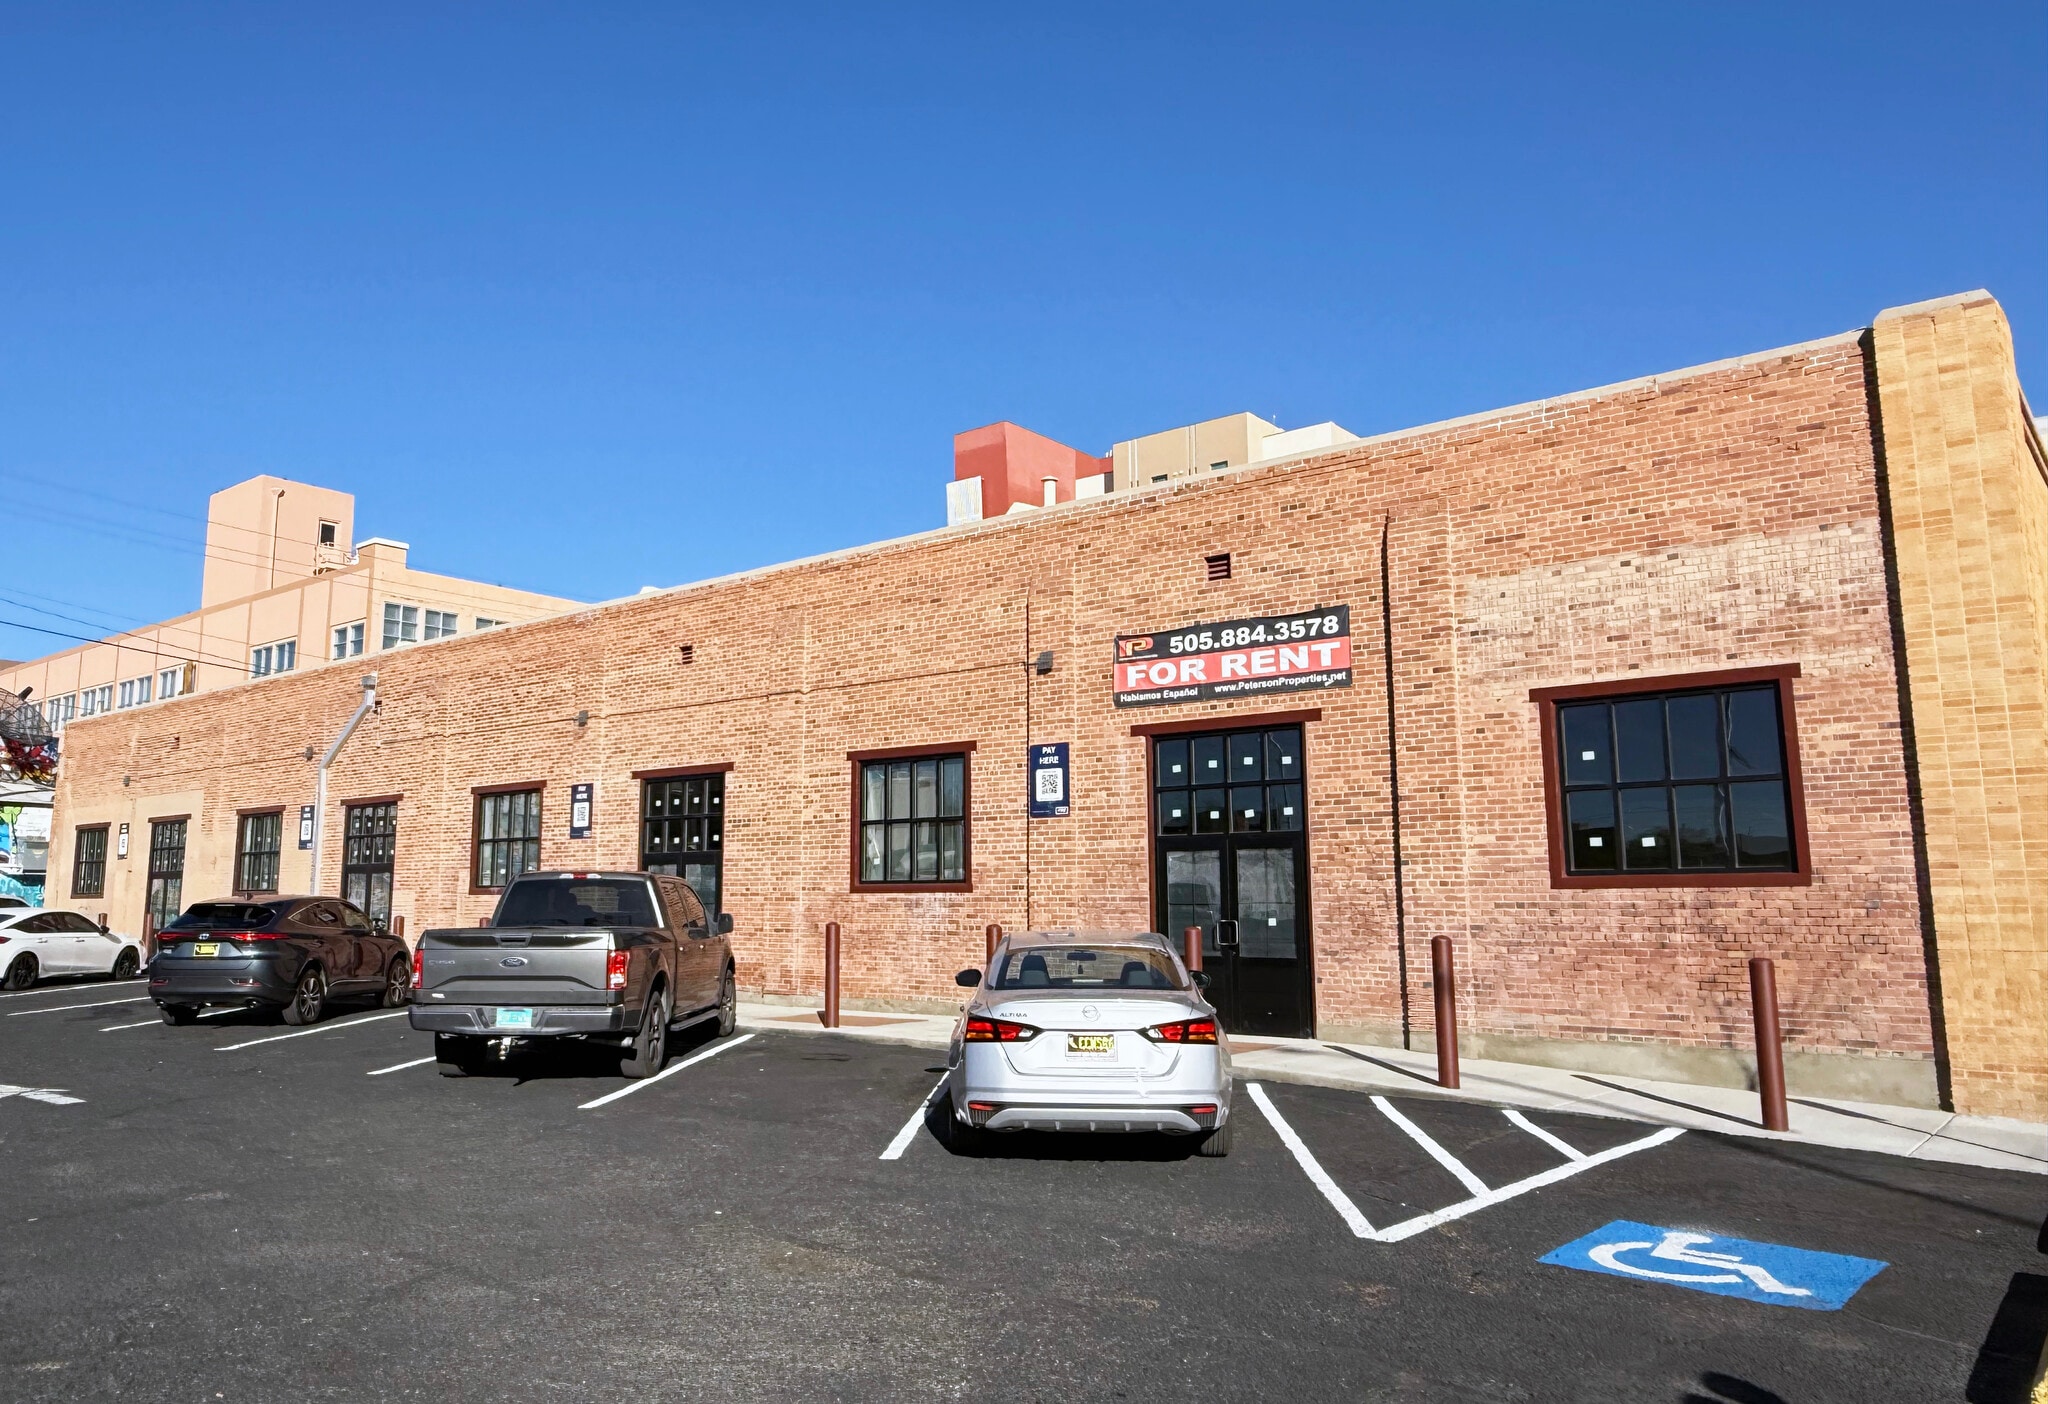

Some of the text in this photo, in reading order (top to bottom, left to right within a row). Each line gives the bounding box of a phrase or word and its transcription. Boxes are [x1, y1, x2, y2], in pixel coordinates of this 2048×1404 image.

[1169, 615, 1340, 654] 505.884.3578
[1127, 642, 1341, 688] FOR RENT
[1214, 671, 1347, 693] www.PetersonProperties.net
[1163, 687, 1198, 700] Español
[1042, 746, 1056, 754] PAY
